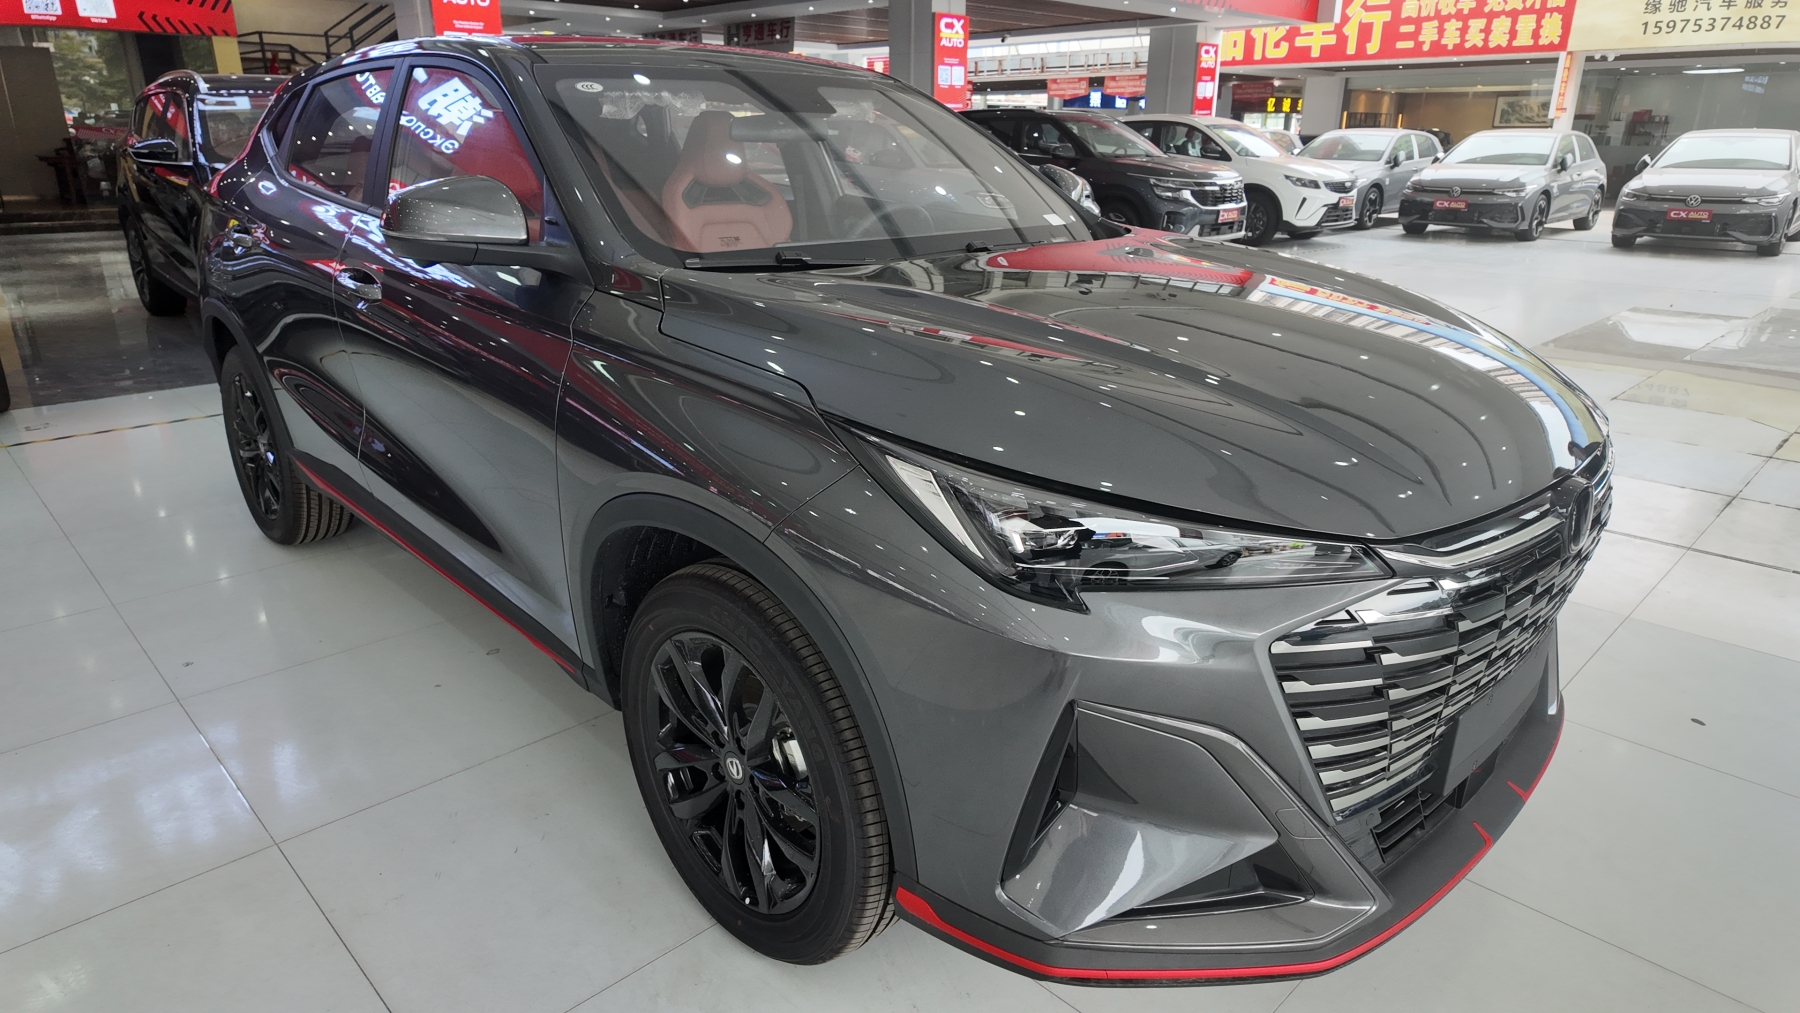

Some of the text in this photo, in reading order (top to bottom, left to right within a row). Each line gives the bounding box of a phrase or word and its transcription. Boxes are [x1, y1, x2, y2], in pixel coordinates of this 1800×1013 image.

[940, 17, 965, 34] CX
[1641, 15, 1787, 35] 15975374887
[1396, 12, 1563, 51] 二手车买卖置换
[940, 38, 965, 48] AUTO
[1201, 45, 1217, 58] CX
[1200, 61, 1216, 69] AUTO
[1436, 200, 1450, 208] CX
[1670, 210, 1689, 218] CX
